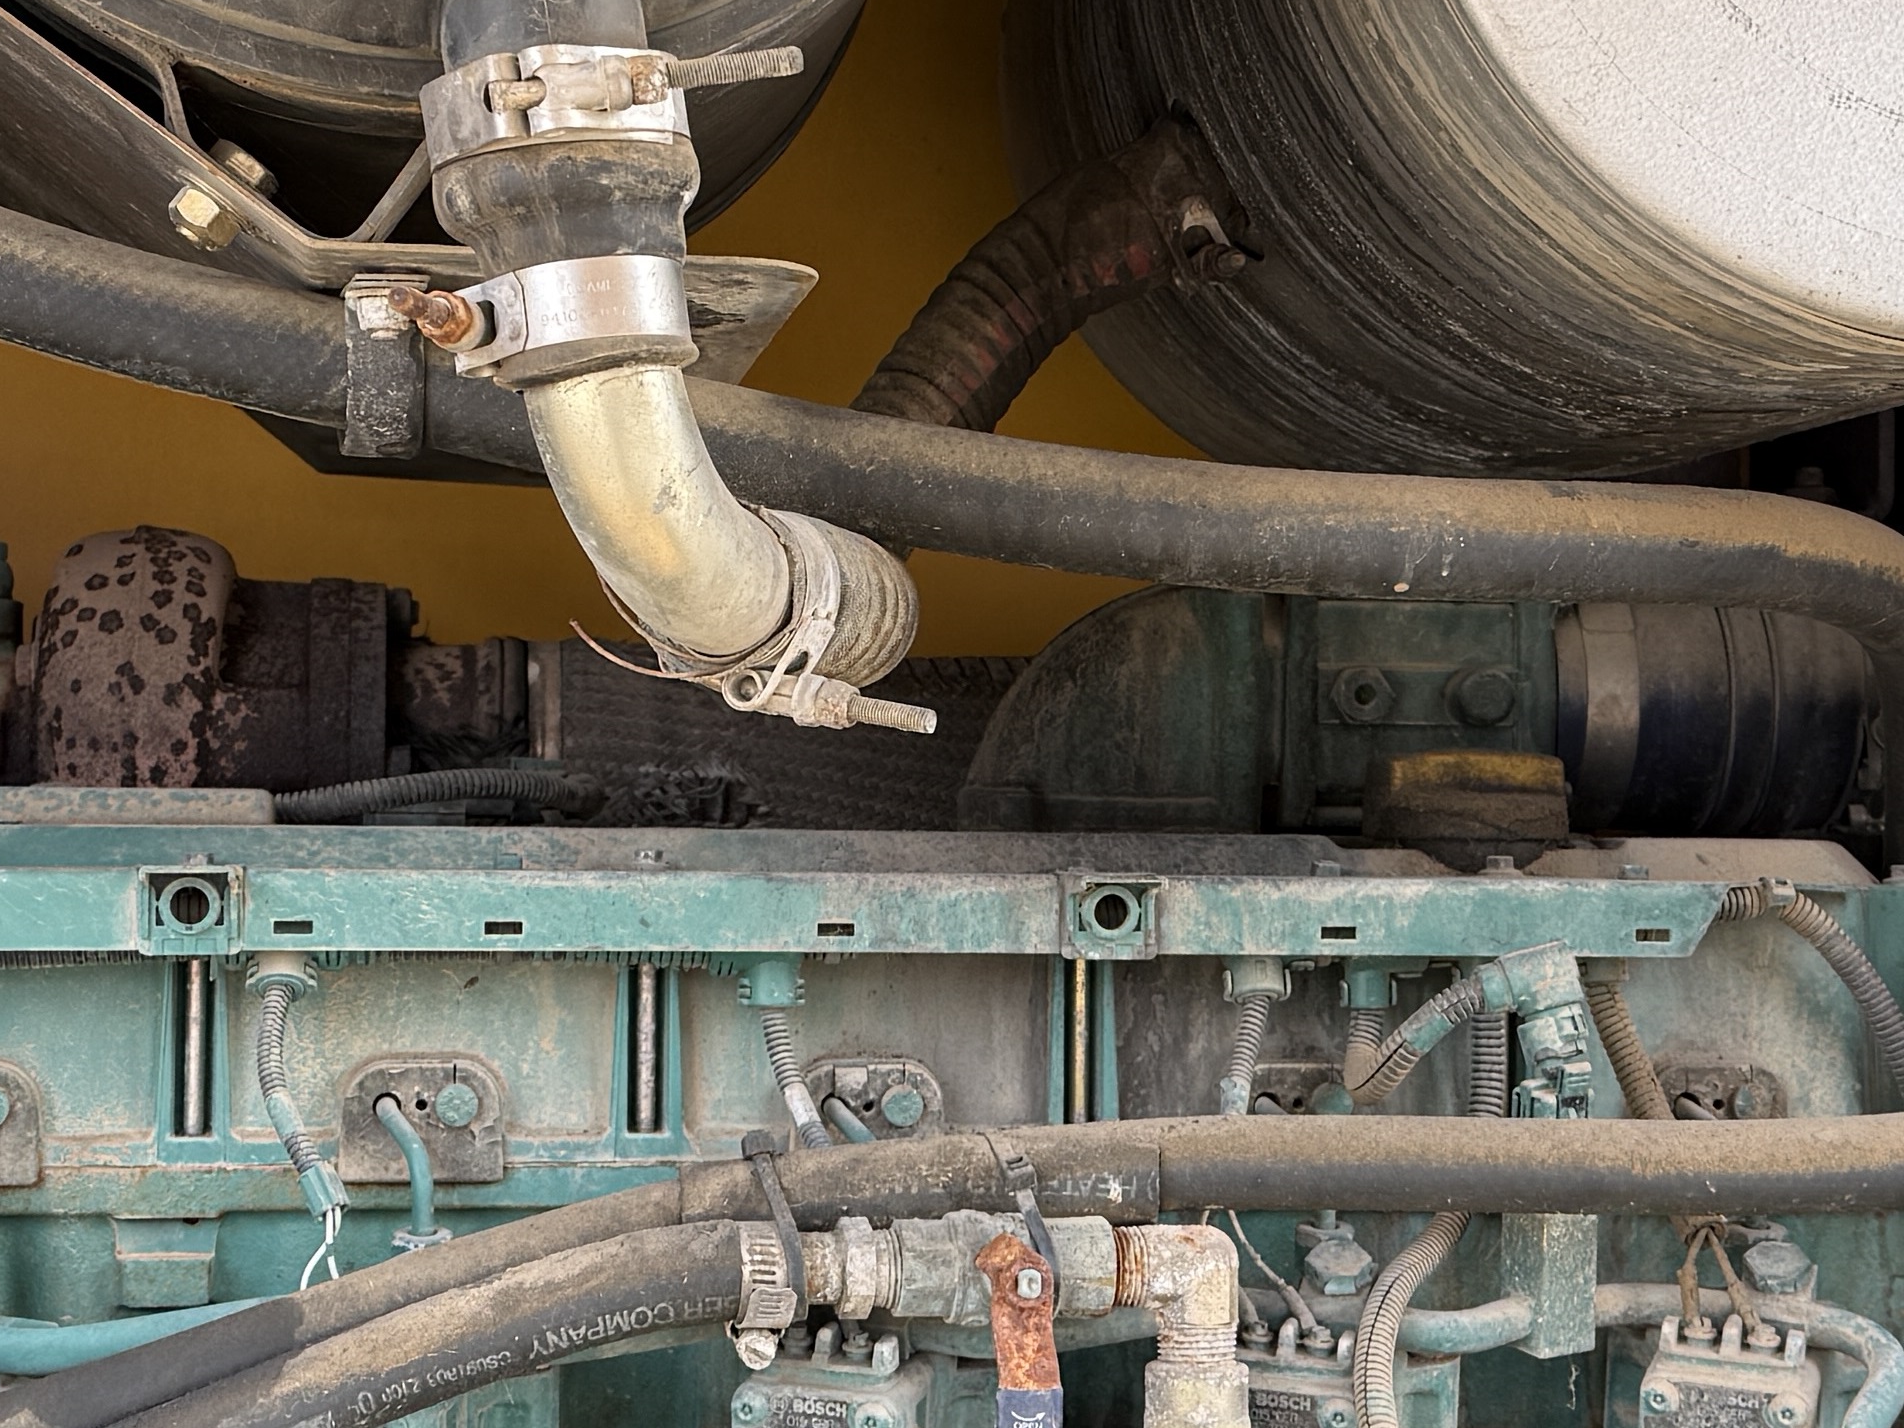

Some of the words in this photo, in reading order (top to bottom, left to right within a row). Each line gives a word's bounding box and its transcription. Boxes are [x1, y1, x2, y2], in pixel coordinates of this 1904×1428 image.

[528, 1302, 674, 1360] COMPANY
[792, 1397, 847, 1417] BOSCH
[1255, 1392, 1311, 1411] BOSCH
